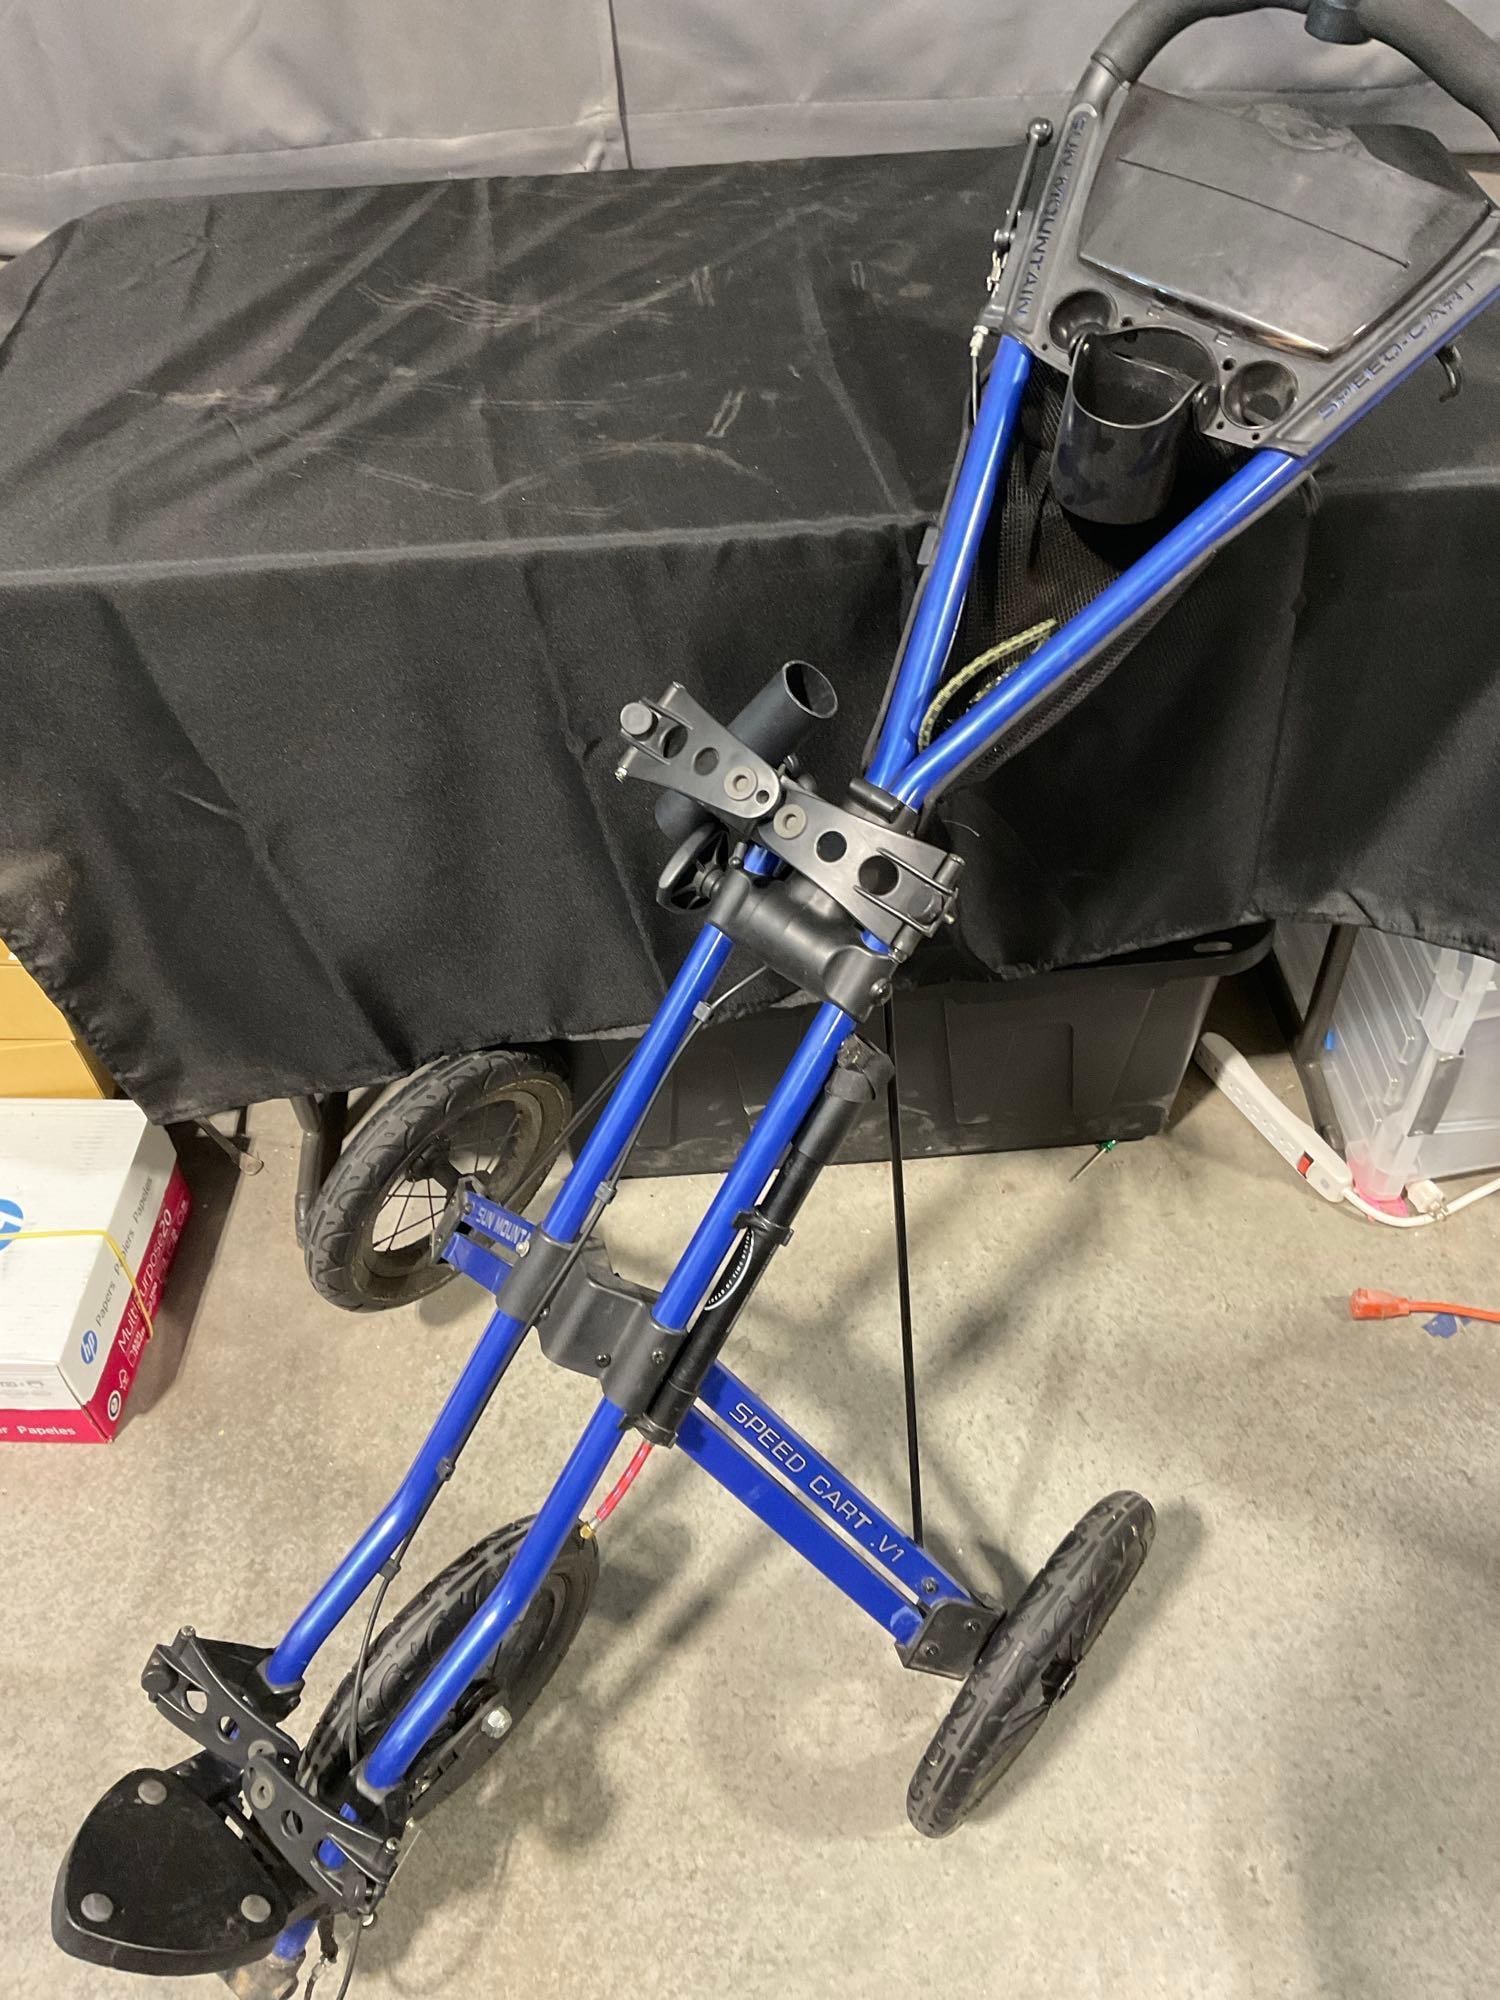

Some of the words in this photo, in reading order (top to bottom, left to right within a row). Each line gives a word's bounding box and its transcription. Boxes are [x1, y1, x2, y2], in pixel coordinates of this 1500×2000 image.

[1057, 116, 1087, 167] SUN
[1016, 175, 1069, 315] MOUNTAIN
[475, 1207, 496, 1230] SUN
[81, 1330, 98, 1364] hp
[95, 1281, 116, 1327] Papers
[114, 1229, 135, 1276] Ppiers
[132, 1177, 153, 1224] Papeles
[16, 1425, 76, 1436] Papeles
[728, 1402, 807, 1473] SPEED
[808, 1474, 873, 1529] CART
